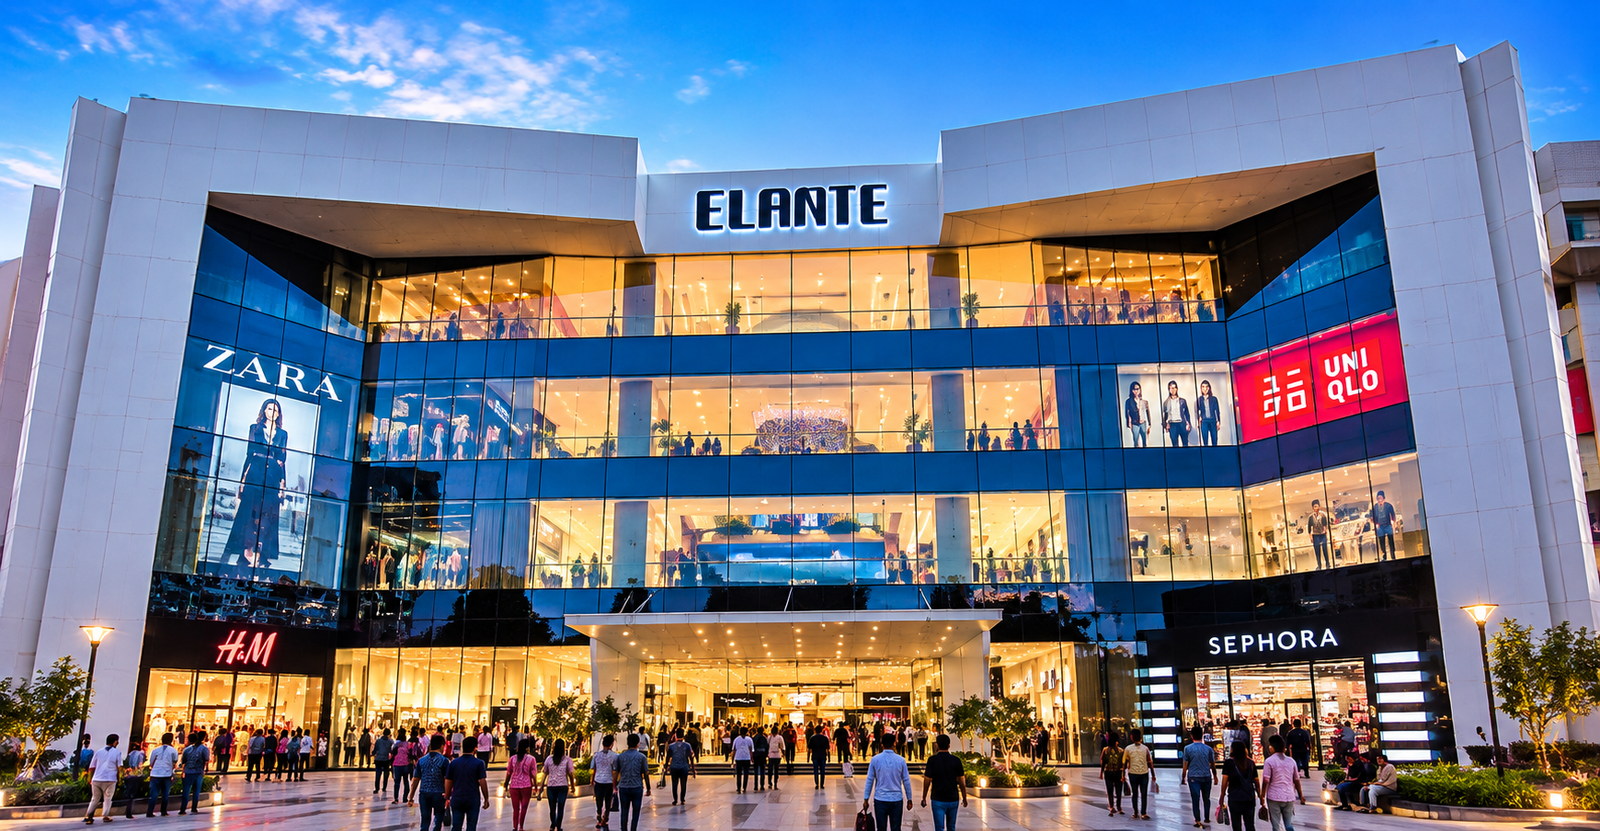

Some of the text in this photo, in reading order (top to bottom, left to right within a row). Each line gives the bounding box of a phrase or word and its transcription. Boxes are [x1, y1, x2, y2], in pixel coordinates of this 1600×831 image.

[695, 184, 888, 231] ELANTE
[203, 344, 342, 402] ZARA
[1324, 347, 1368, 378] UNI
[1327, 369, 1379, 403] QLO
[216, 630, 277, 667] H&M
[1208, 628, 1339, 655] SEPHORA
